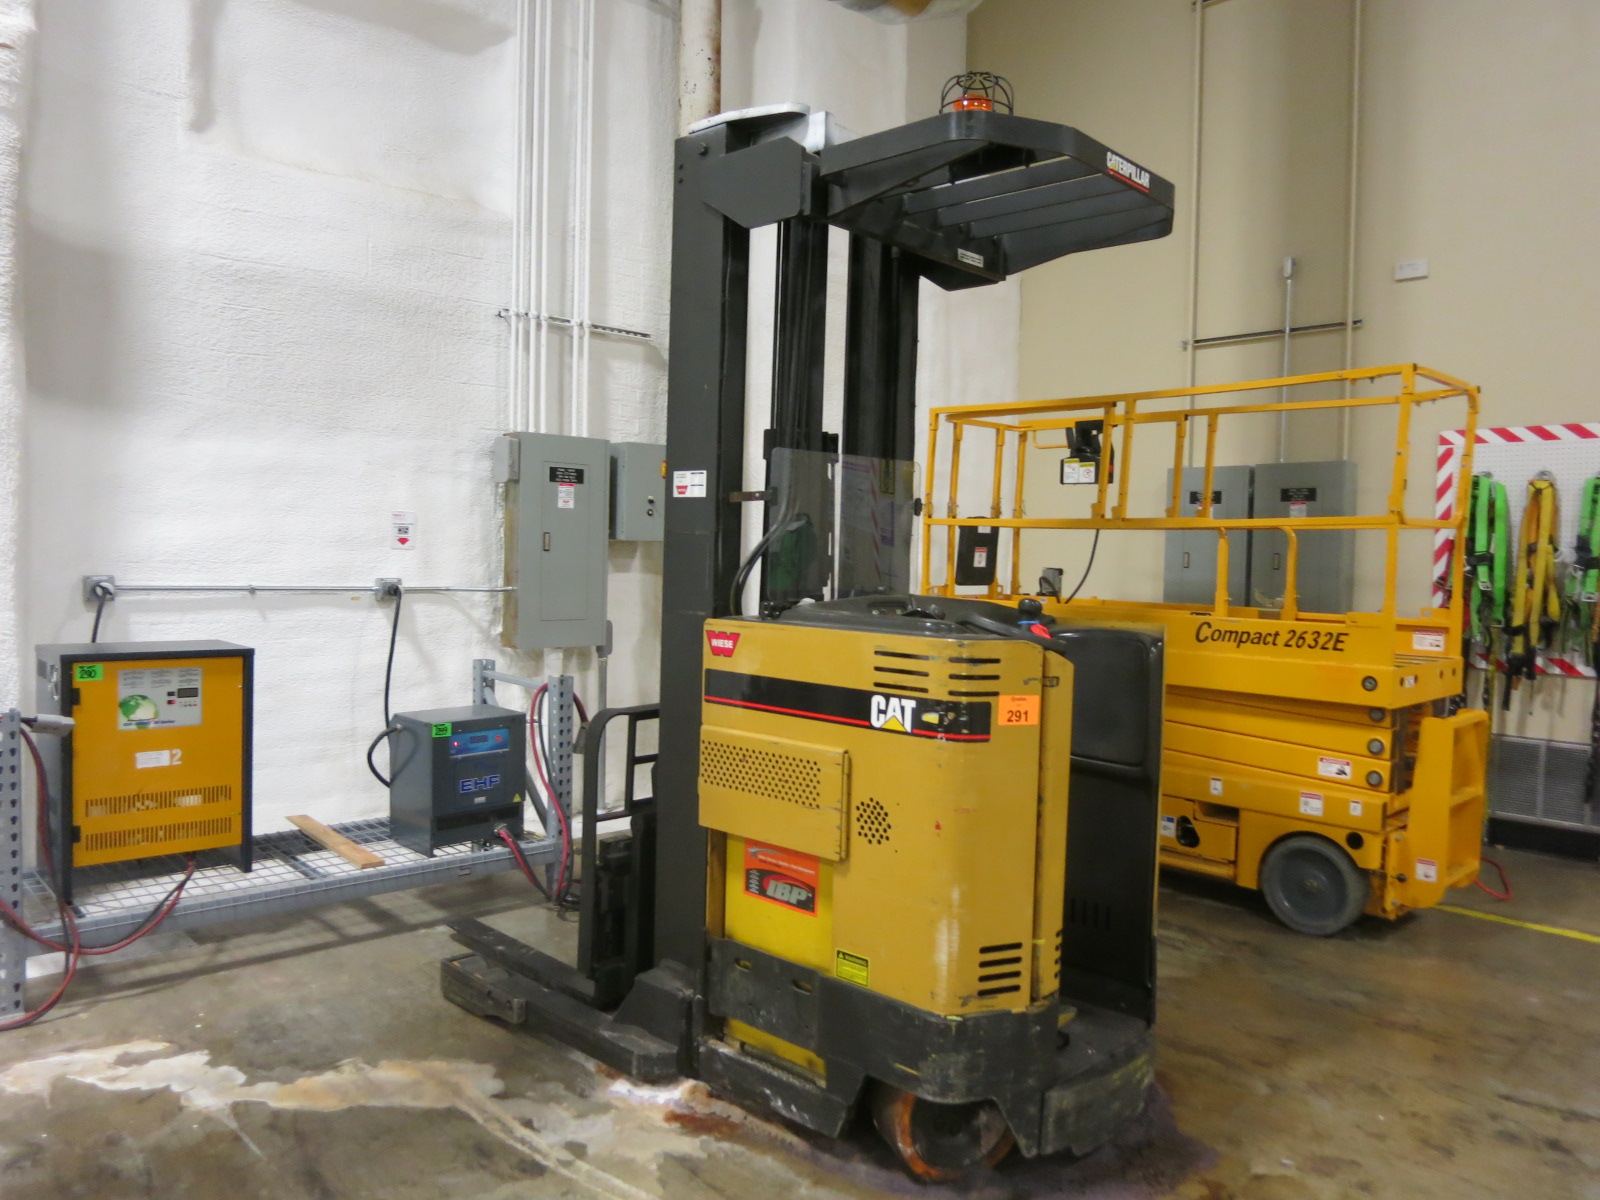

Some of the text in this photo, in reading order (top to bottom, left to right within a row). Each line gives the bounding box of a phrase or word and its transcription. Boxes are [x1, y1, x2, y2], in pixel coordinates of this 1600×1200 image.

[1107, 151, 1150, 189] CATERPILLAR
[711, 638, 734, 649] WIESE
[1195, 621, 1350, 652] Compact 2632E
[870, 694, 916, 733] CAT
[1007, 709, 1030, 723] 291
[460, 774, 501, 794] EHF
[766, 879, 808, 905] IBP
